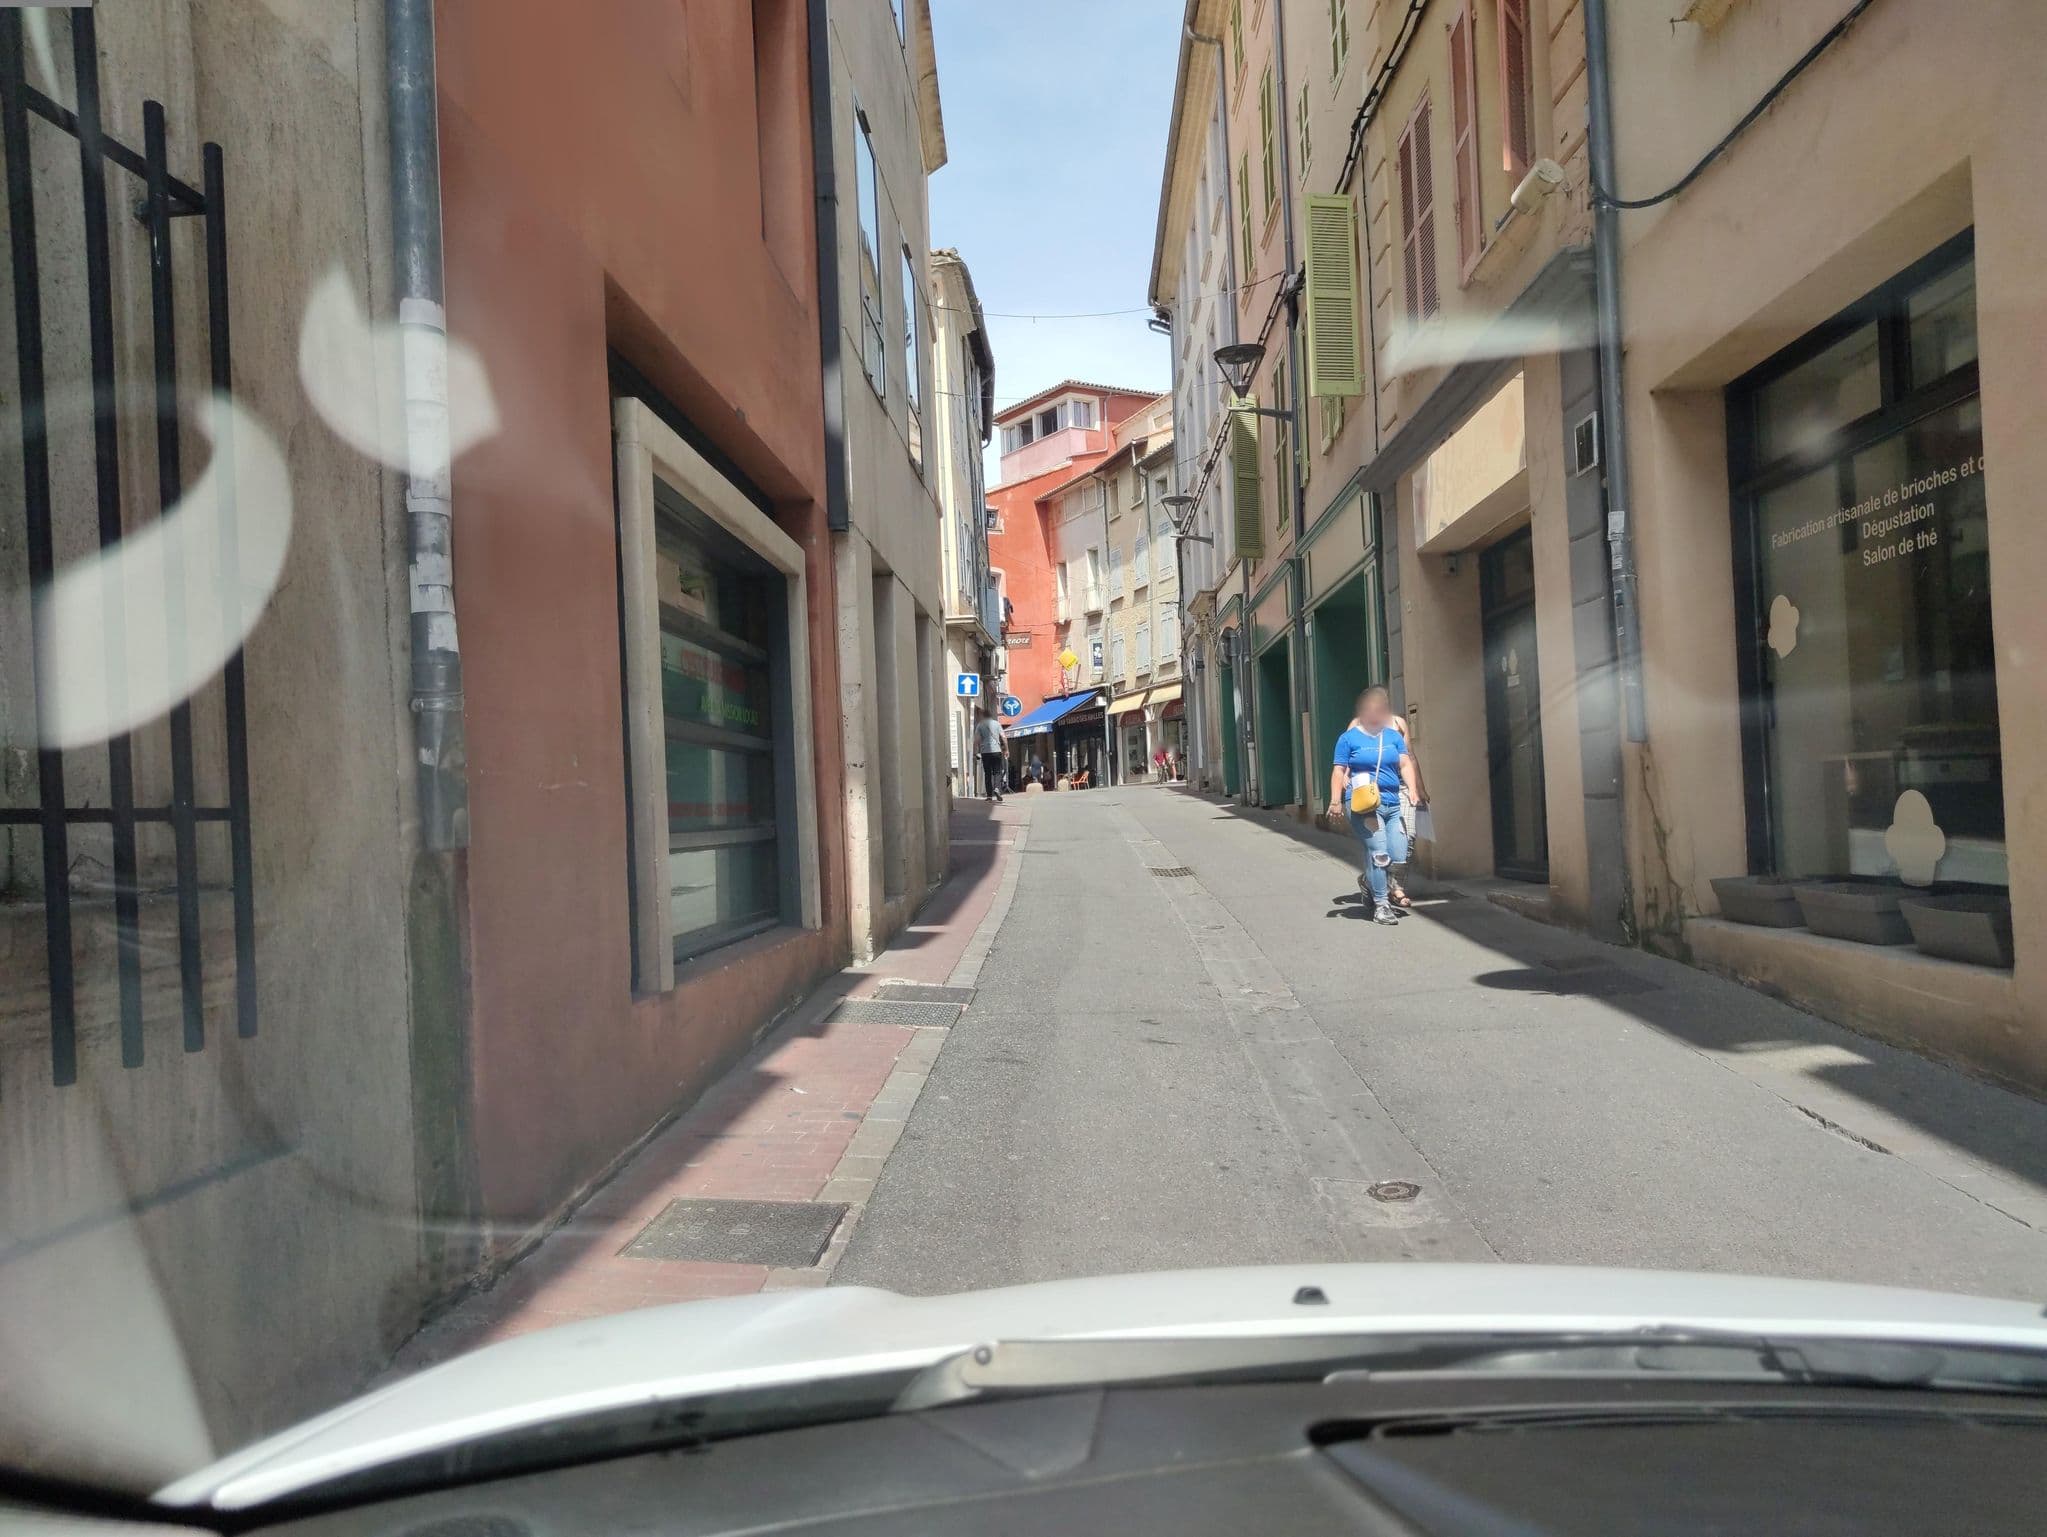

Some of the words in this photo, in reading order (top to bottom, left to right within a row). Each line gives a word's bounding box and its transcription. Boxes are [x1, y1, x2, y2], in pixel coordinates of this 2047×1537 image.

[1771, 518, 1825, 551] Fabrication
[1826, 497, 1881, 529] artisanale
[1883, 488, 1899, 508] de
[1901, 465, 1957, 501] brioches
[1960, 455, 1976, 478] et
[1862, 502, 1935, 539] Dégustation
[1863, 546, 1896, 567] Salon
[1898, 538, 1914, 556] de
[1917, 527, 1938, 549] thé
